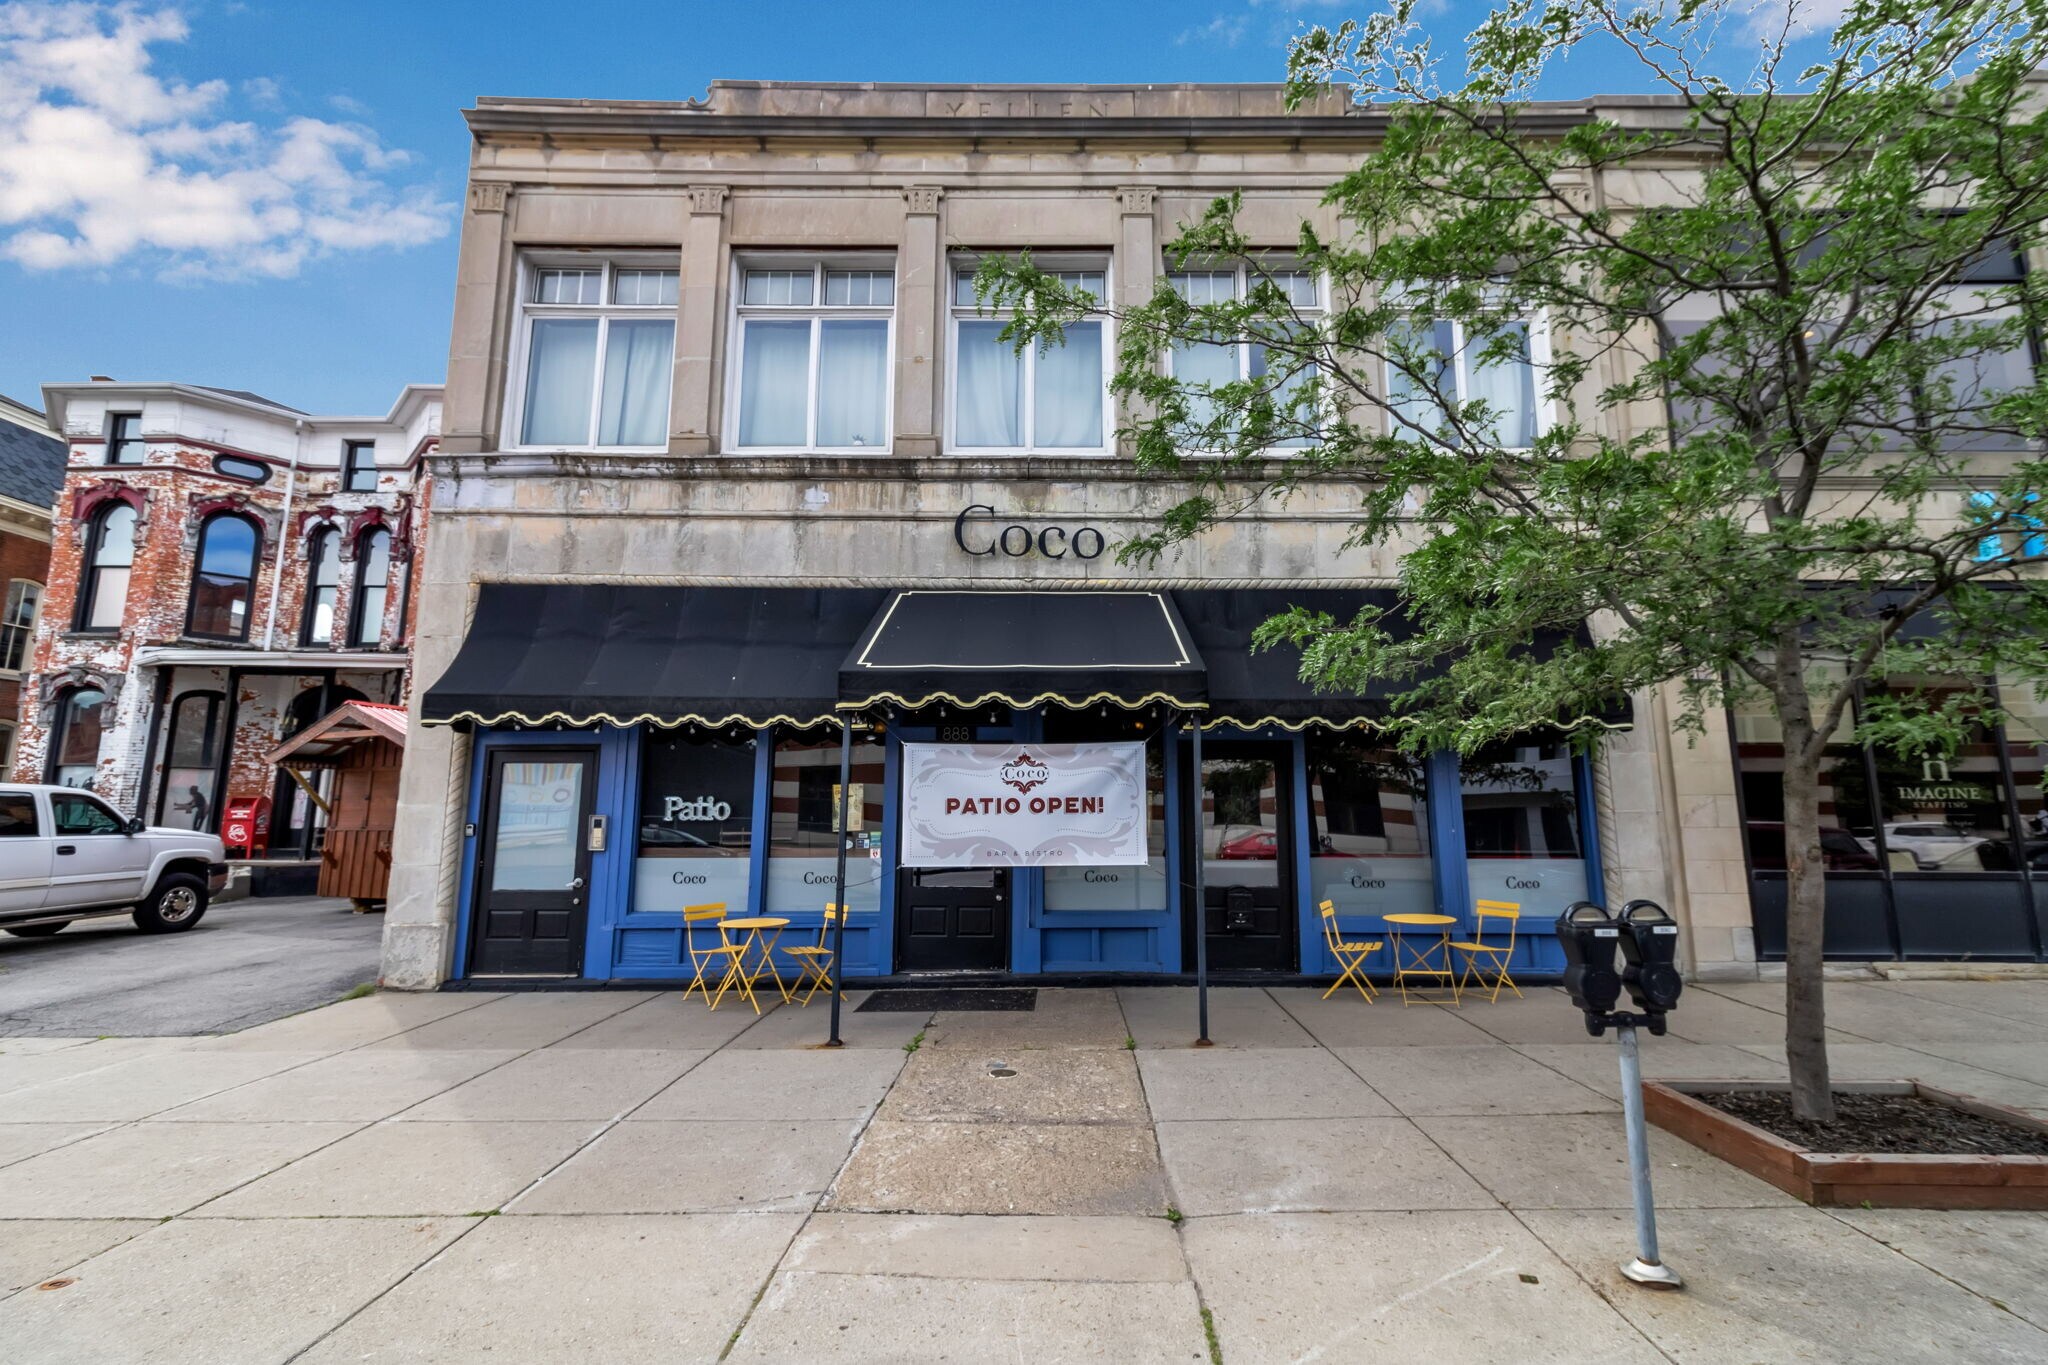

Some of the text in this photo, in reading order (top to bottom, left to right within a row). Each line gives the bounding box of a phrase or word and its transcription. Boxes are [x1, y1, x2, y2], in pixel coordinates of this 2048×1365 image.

[955, 504, 1105, 560] Coco
[943, 727, 969, 741] 888
[1004, 768, 1046, 780] Coco
[1897, 786, 1982, 800] IMAGINE
[663, 796, 732, 822] Patio
[945, 797, 1104, 815] PATIO OPEN!
[1912, 801, 1968, 809] STAFFING
[1025, 849, 1063, 857] BISTRO
[672, 871, 707, 885] Coco
[803, 871, 838, 885] Coco
[1084, 869, 1119, 883] Coco
[1351, 875, 1386, 889] Coco
[1505, 875, 1541, 890] Coco
